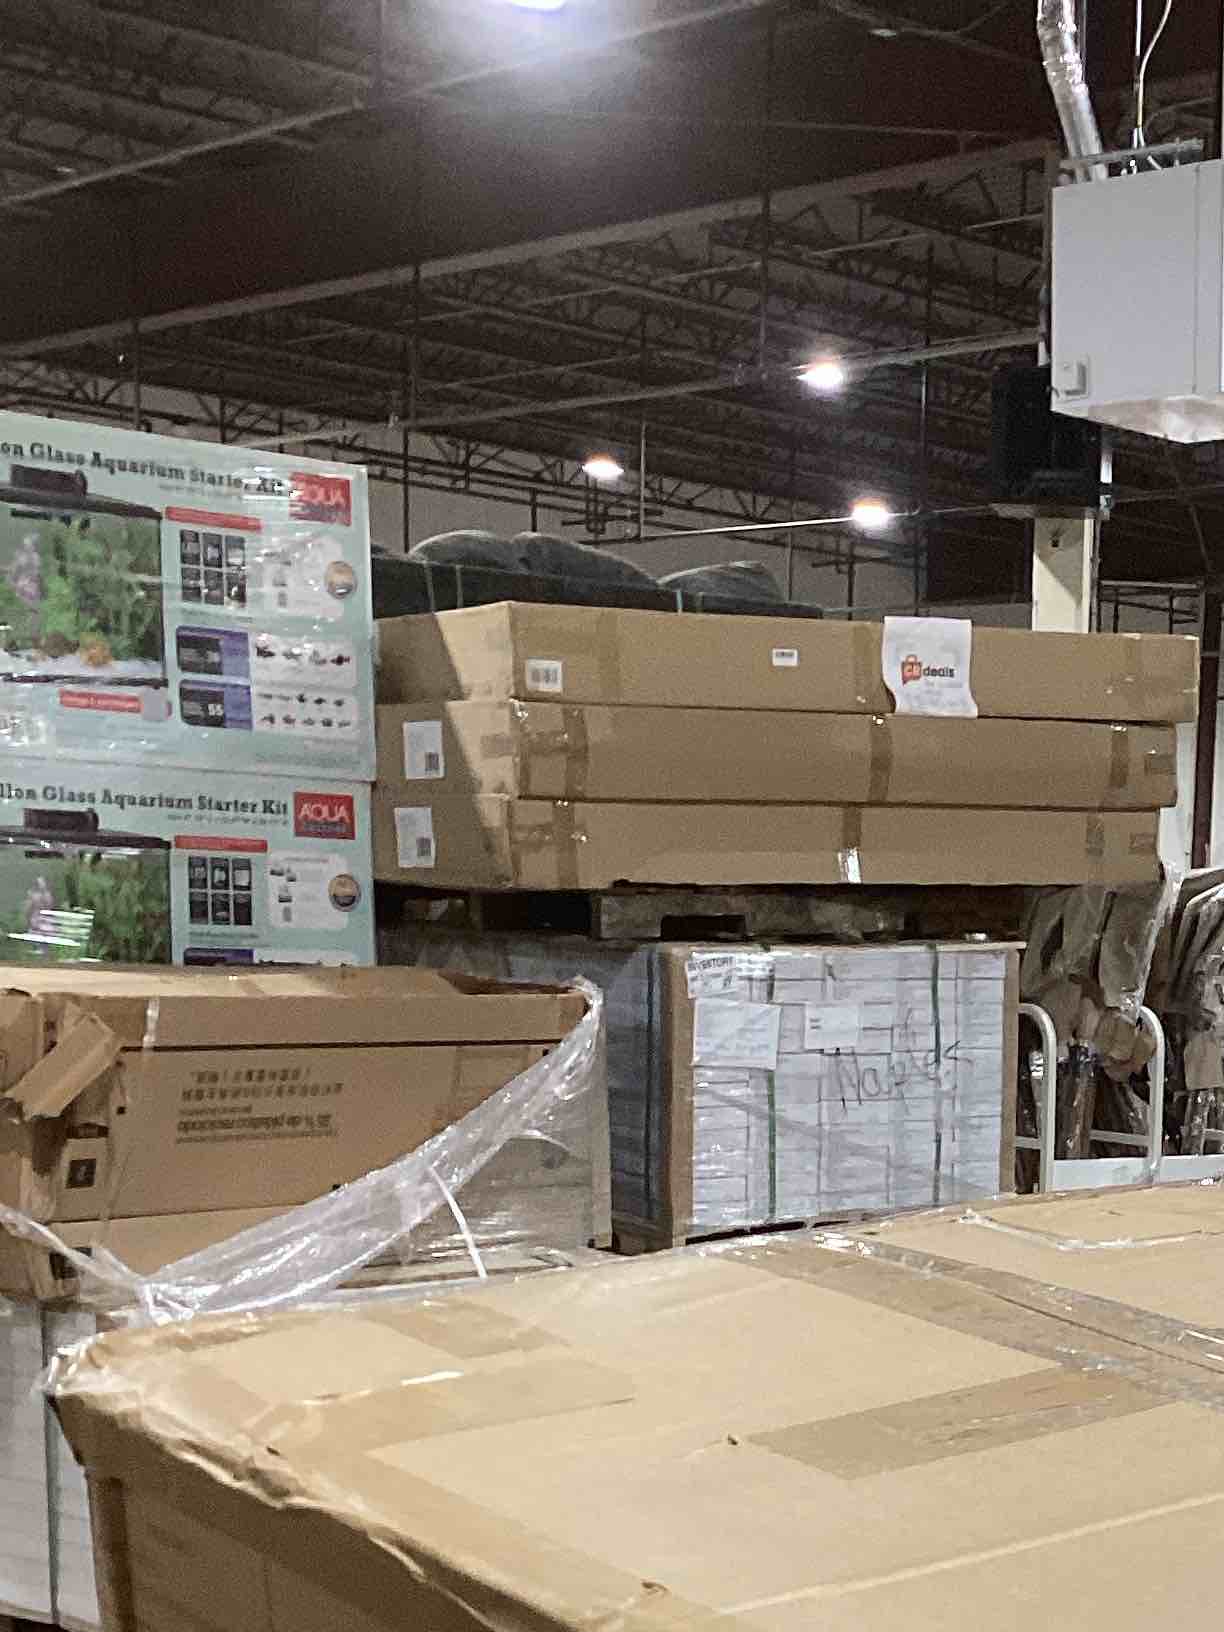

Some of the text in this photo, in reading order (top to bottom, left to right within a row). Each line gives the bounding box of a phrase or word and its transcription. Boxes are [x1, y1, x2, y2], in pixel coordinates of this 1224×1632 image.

[30, 443, 86, 466] Glass
[90, 451, 186, 481] Aquarium
[923, 665, 955, 678] deals
[42, 786, 97, 805] Glass
[101, 788, 193, 812] Aquarium
[197, 795, 258, 815] Starter
[261, 799, 289, 815] Kit
[300, 802, 350, 820] AQUA
